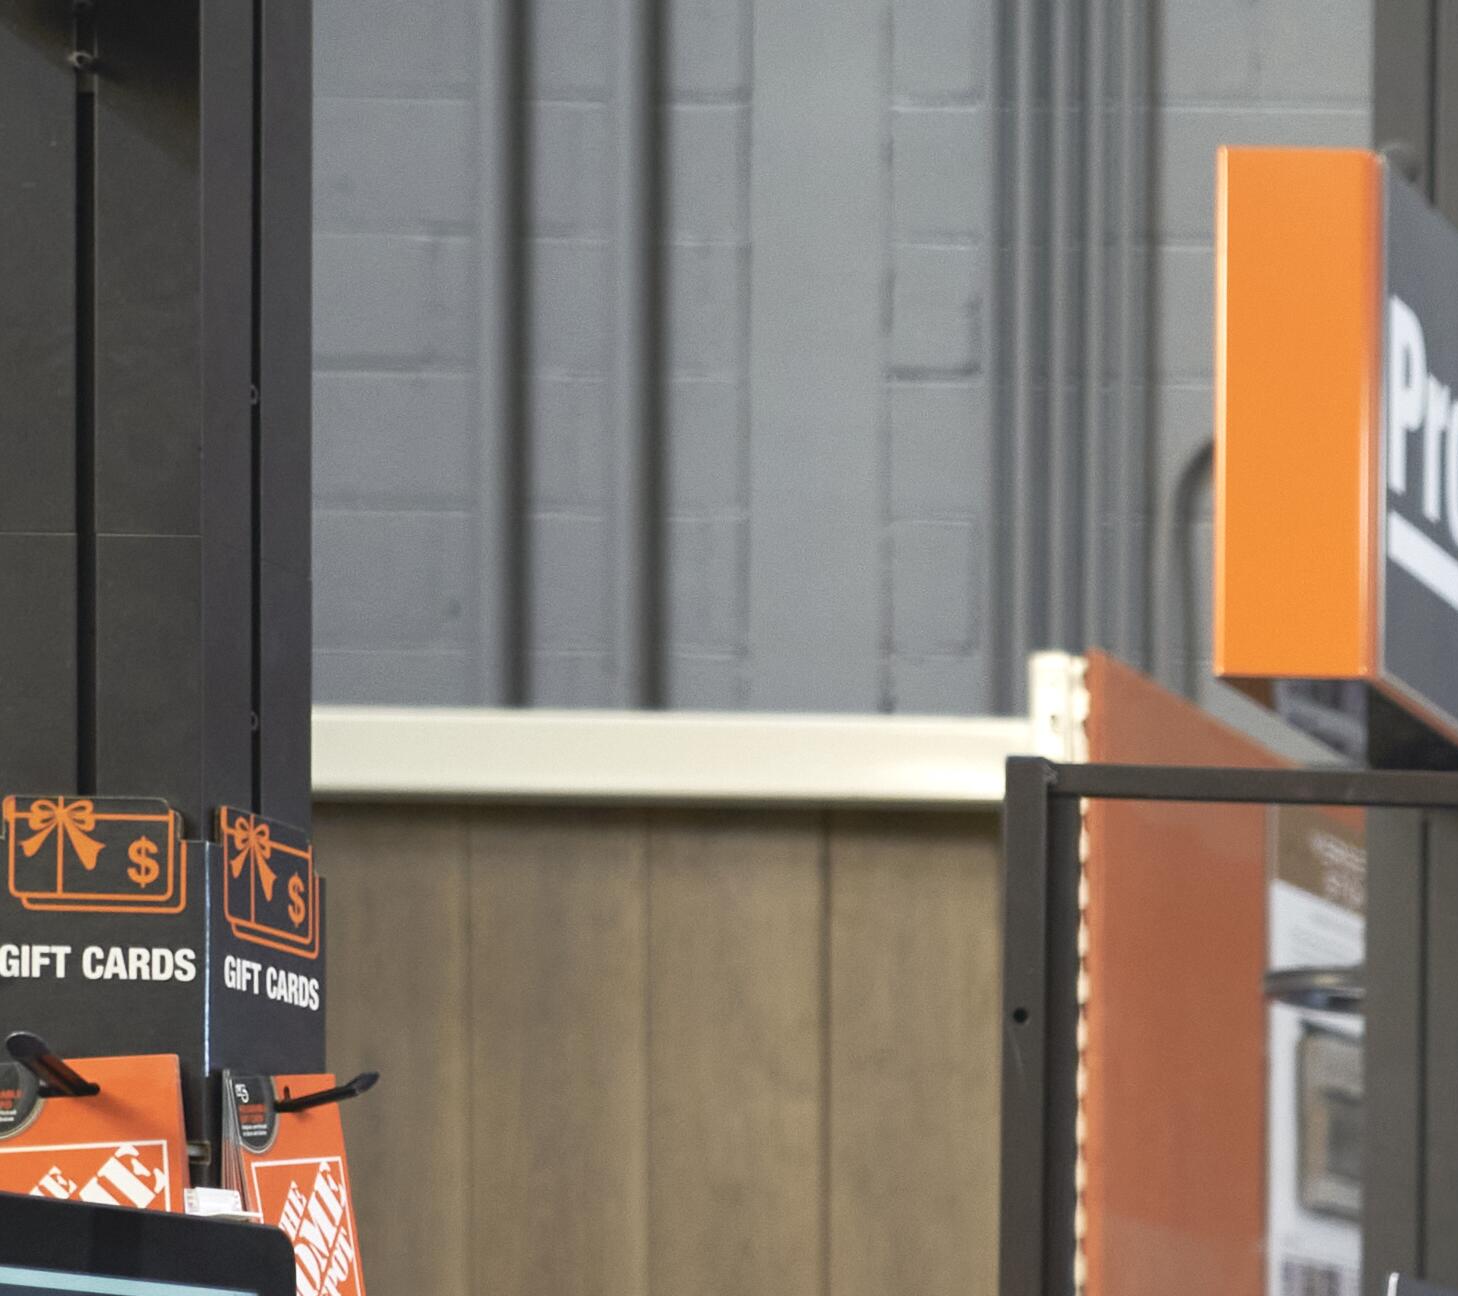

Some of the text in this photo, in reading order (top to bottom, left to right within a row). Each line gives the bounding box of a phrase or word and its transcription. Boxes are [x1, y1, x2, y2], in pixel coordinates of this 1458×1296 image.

[0, 944, 198, 983] GIFT CARDS
[223, 955, 321, 1012] GIFT CARDS
